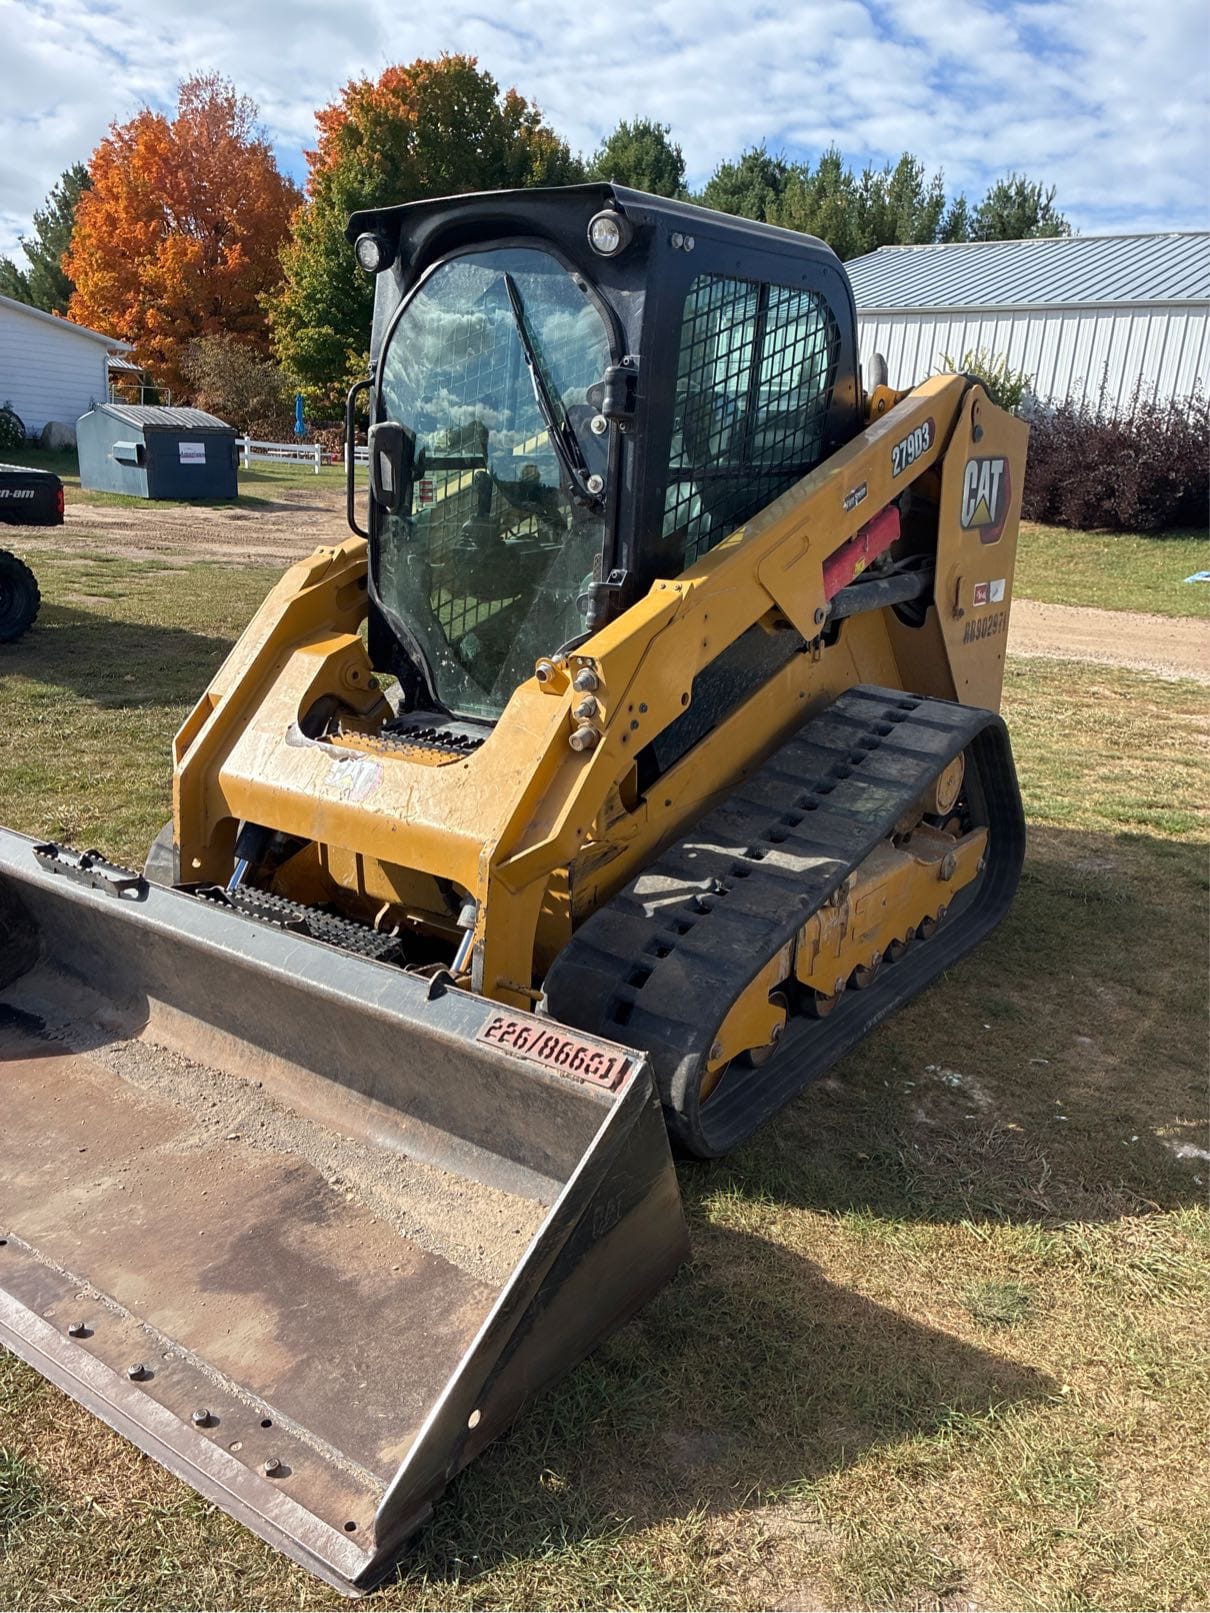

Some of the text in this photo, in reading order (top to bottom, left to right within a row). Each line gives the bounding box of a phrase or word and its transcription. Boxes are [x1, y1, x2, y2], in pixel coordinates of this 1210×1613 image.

[891, 422, 930, 477] 279D3
[0, 489, 35, 498] n-am
[961, 459, 1004, 528] CAT
